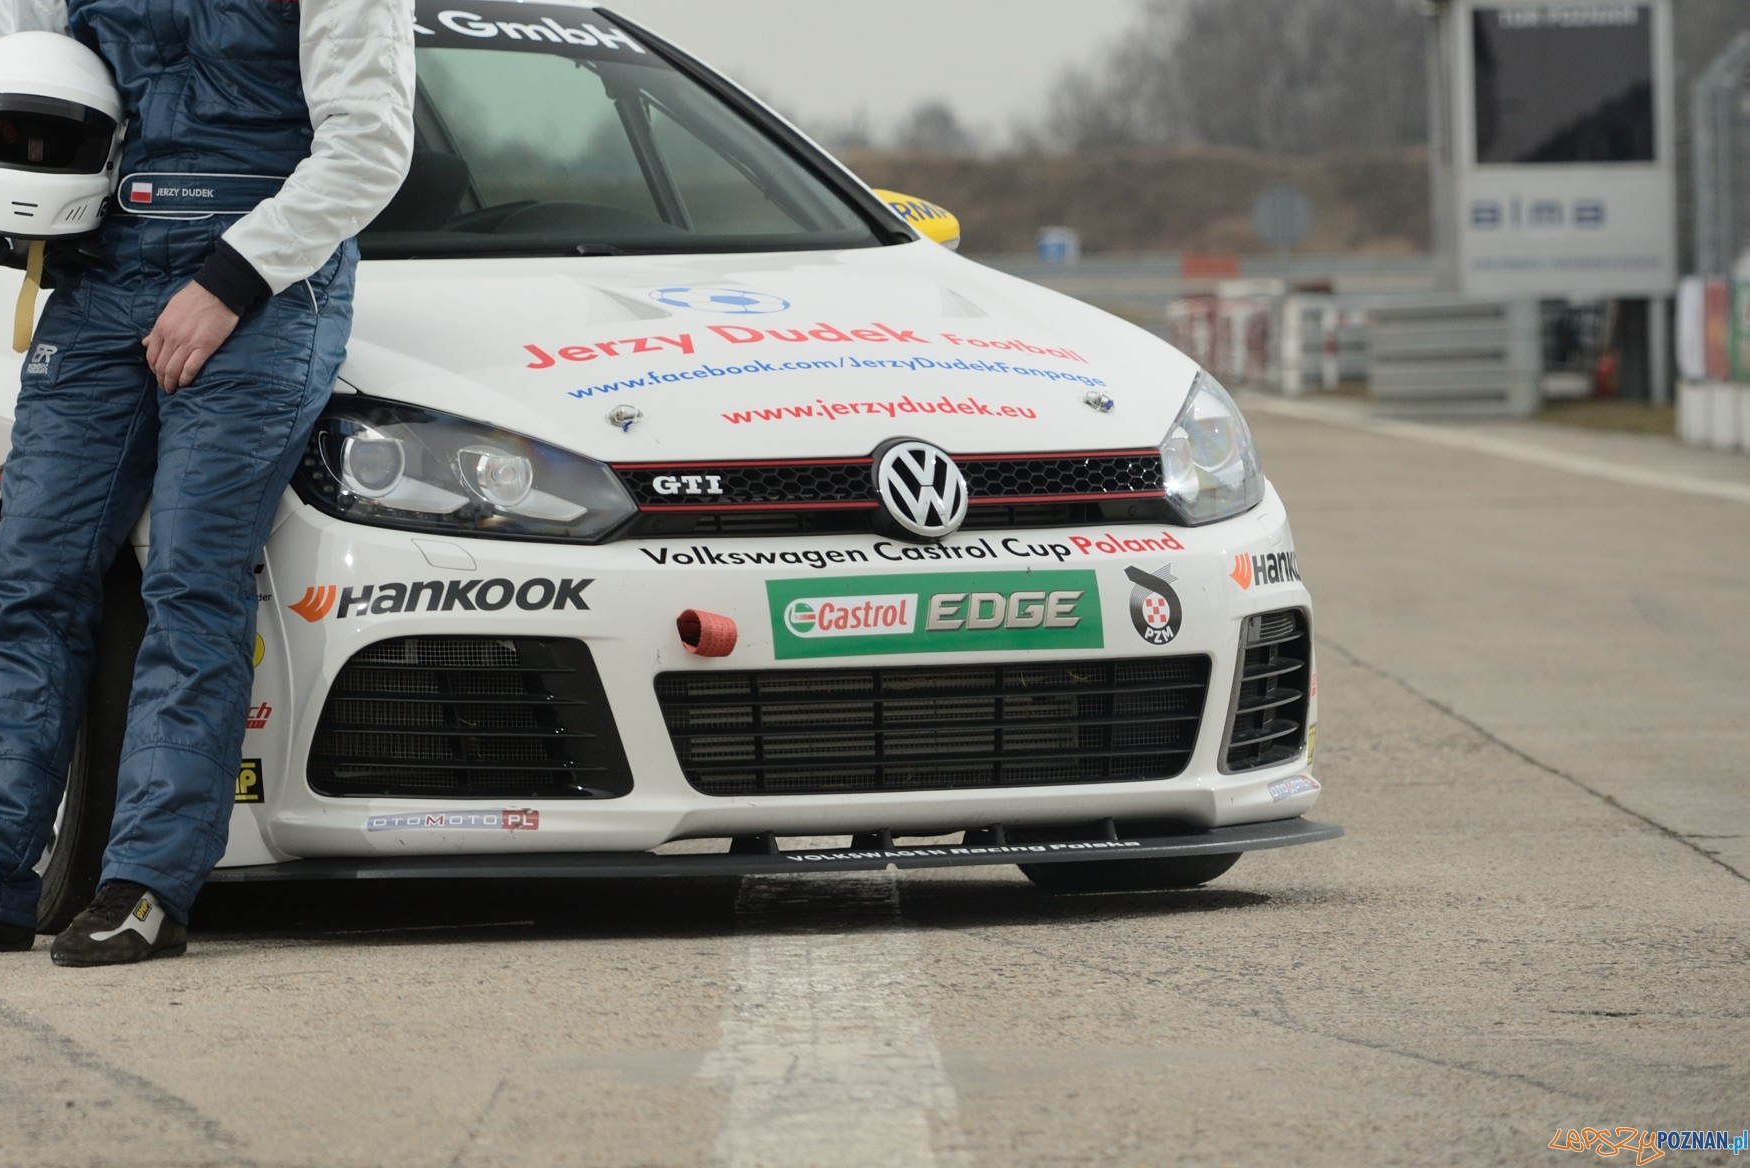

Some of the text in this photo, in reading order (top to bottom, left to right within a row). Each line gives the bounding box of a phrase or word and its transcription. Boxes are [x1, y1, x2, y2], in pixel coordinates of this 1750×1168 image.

[437, 10, 646, 54] GmbH
[156, 188, 214, 198] JERZY DUDEK
[522, 322, 1089, 369] Jerzy Dudek Football
[567, 356, 1107, 398] www.facebook.com/JerzyDudekFanpage
[721, 395, 1037, 424] www.jerzydudek.eu
[652, 475, 723, 494] GTI
[640, 531, 1186, 569] Volkswagen Castrol Cup Poland
[817, 589, 1086, 632] Castrol EDGE
[1144, 625, 1174, 643] PZM
[787, 840, 1141, 862] VOLKSWAGEN Racing Polska
